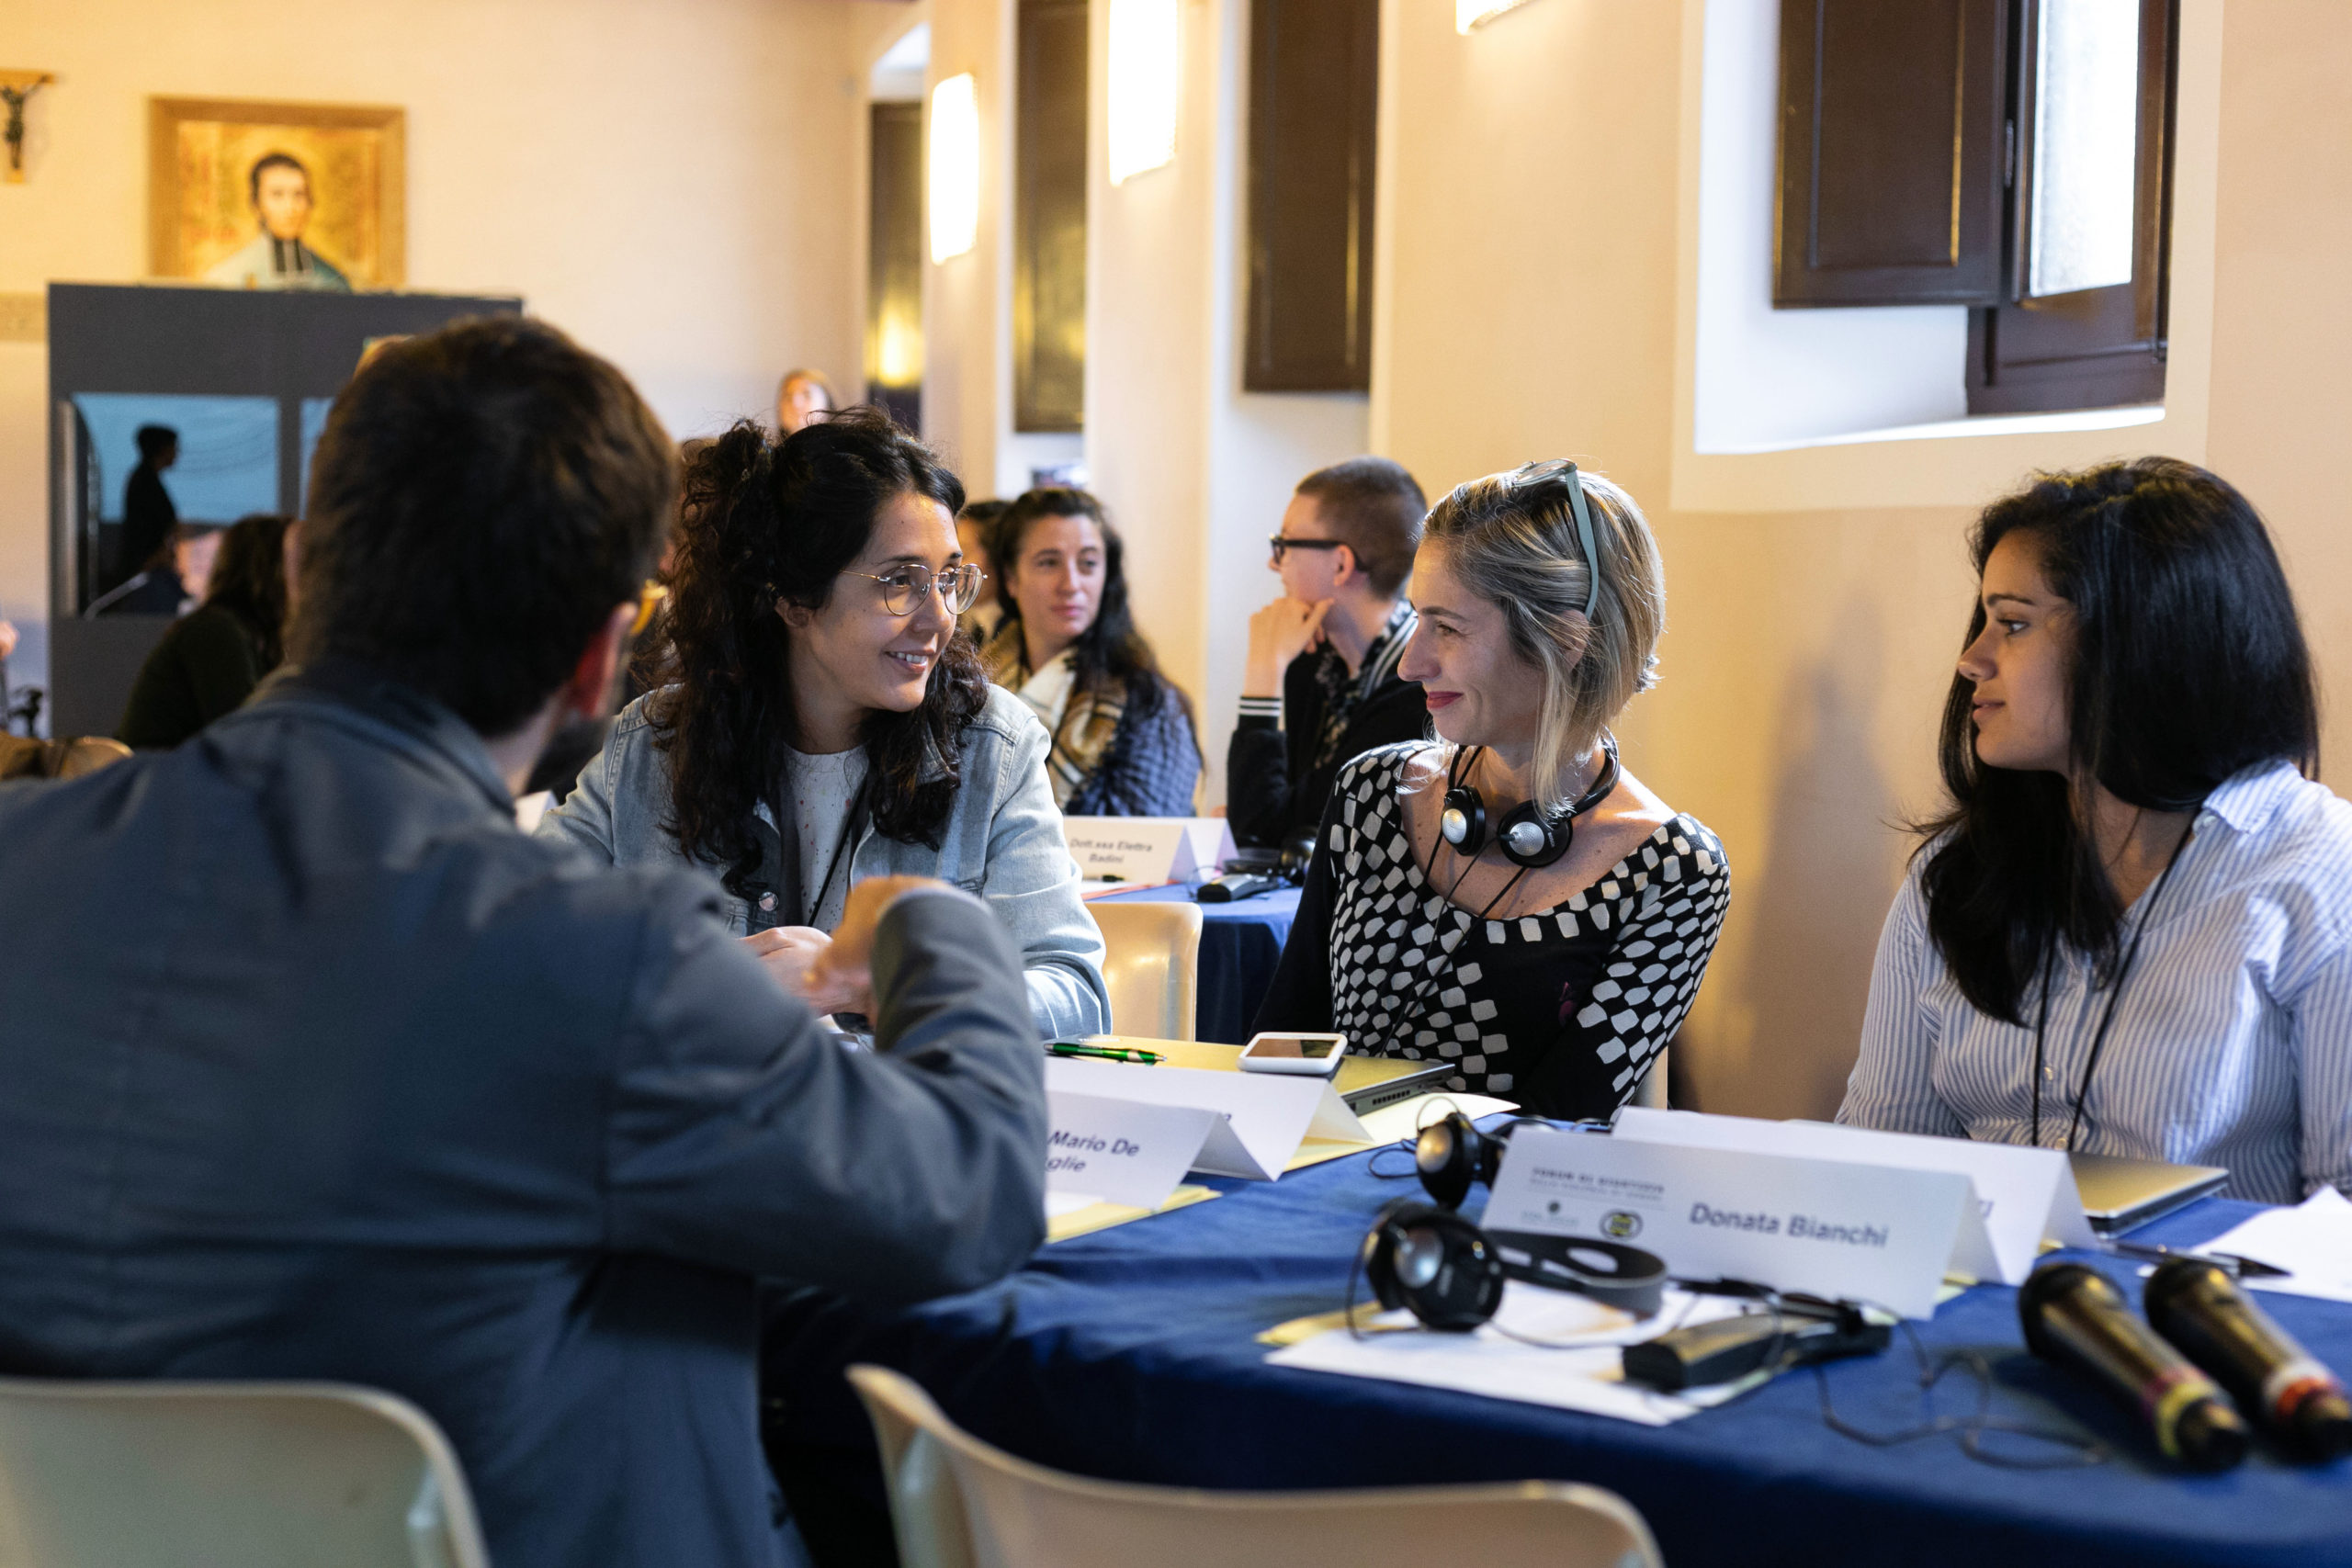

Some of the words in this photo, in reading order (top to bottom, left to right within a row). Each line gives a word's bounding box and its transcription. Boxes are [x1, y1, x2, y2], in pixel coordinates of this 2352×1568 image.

[1046, 1130, 1106, 1153] Mario
[1111, 1138, 1140, 1156] De
[1046, 1156, 1086, 1172] glie
[1690, 1201, 1781, 1235] Donata
[1787, 1213, 1890, 1248] Bianchi
